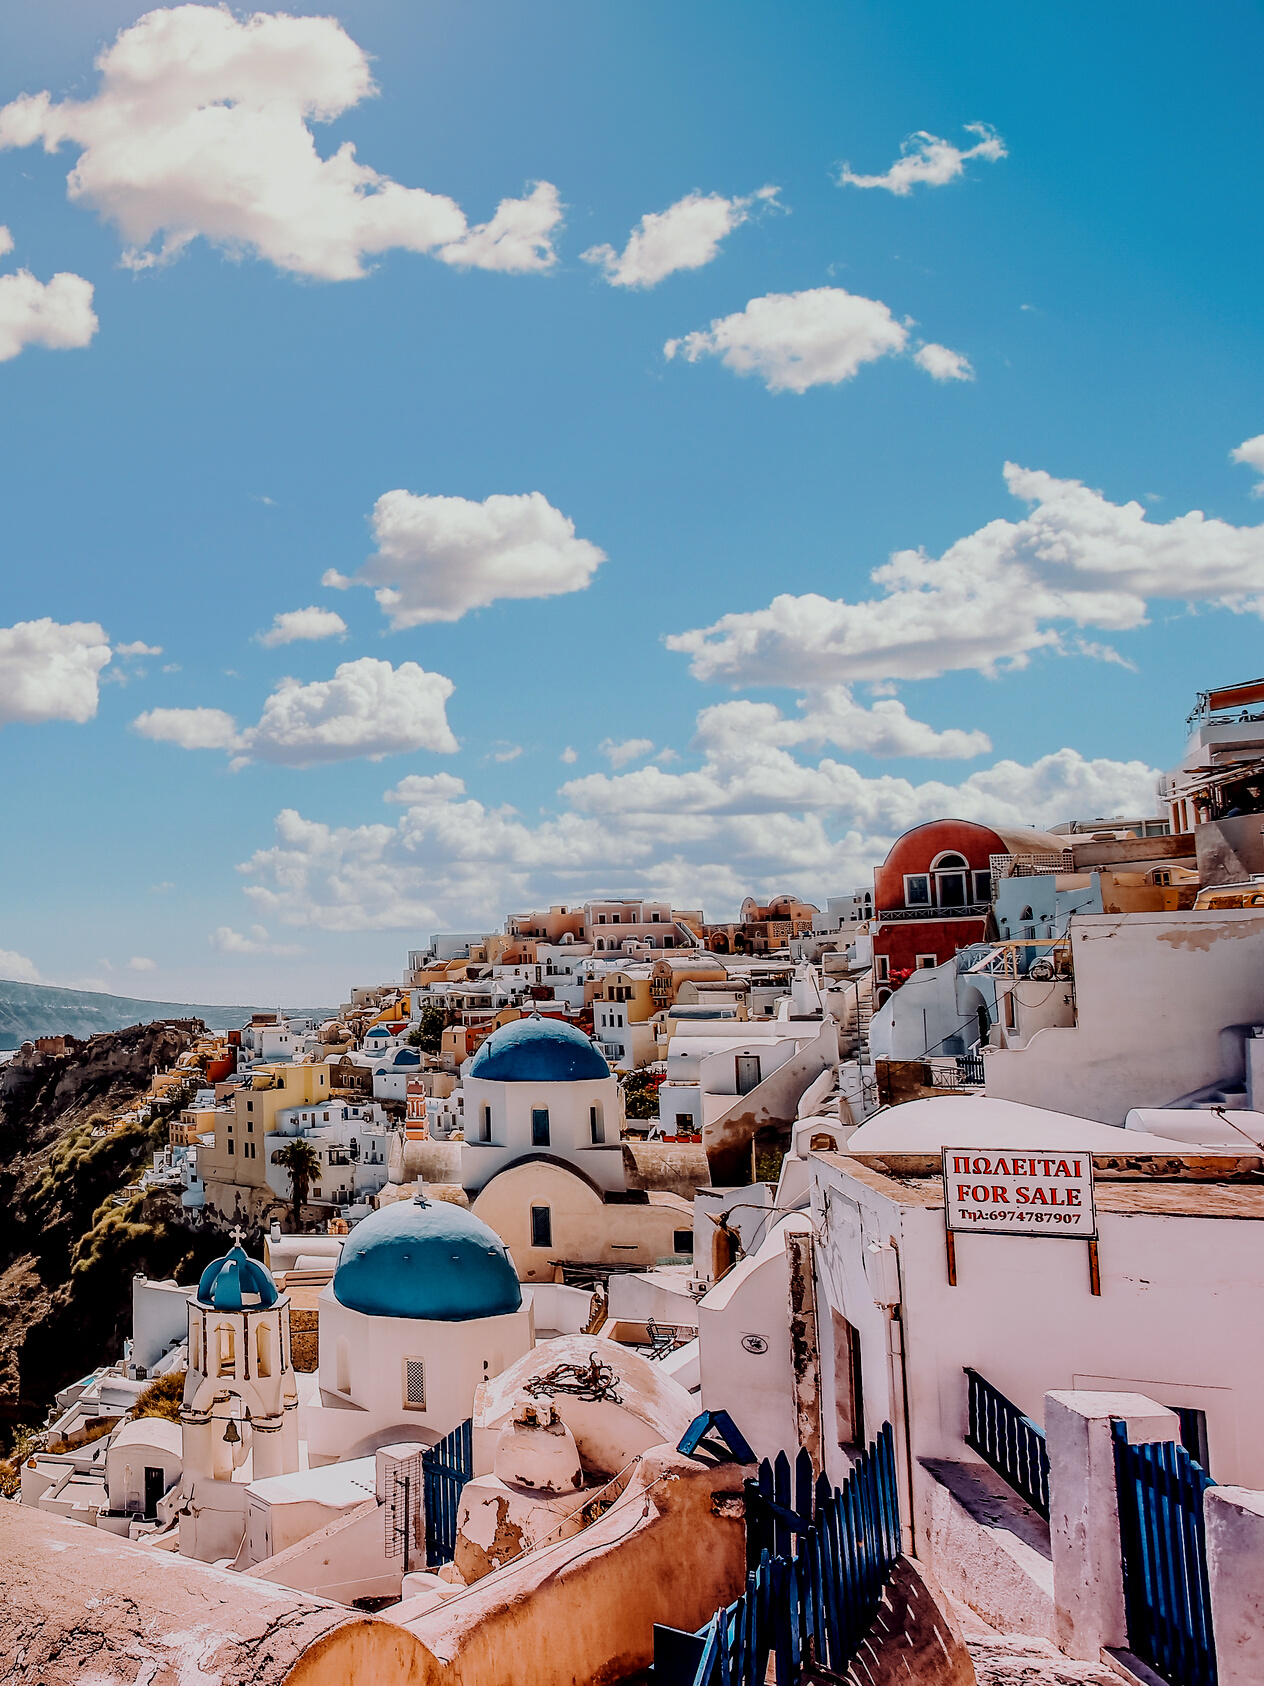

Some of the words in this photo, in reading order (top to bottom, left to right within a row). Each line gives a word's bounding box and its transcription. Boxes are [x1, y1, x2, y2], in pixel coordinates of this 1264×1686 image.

[952, 1156, 1083, 1178] ΠΩΛΕΙΤΑΙ
[956, 1184, 1010, 1204] FOR
[1015, 1186, 1082, 1206] SALE
